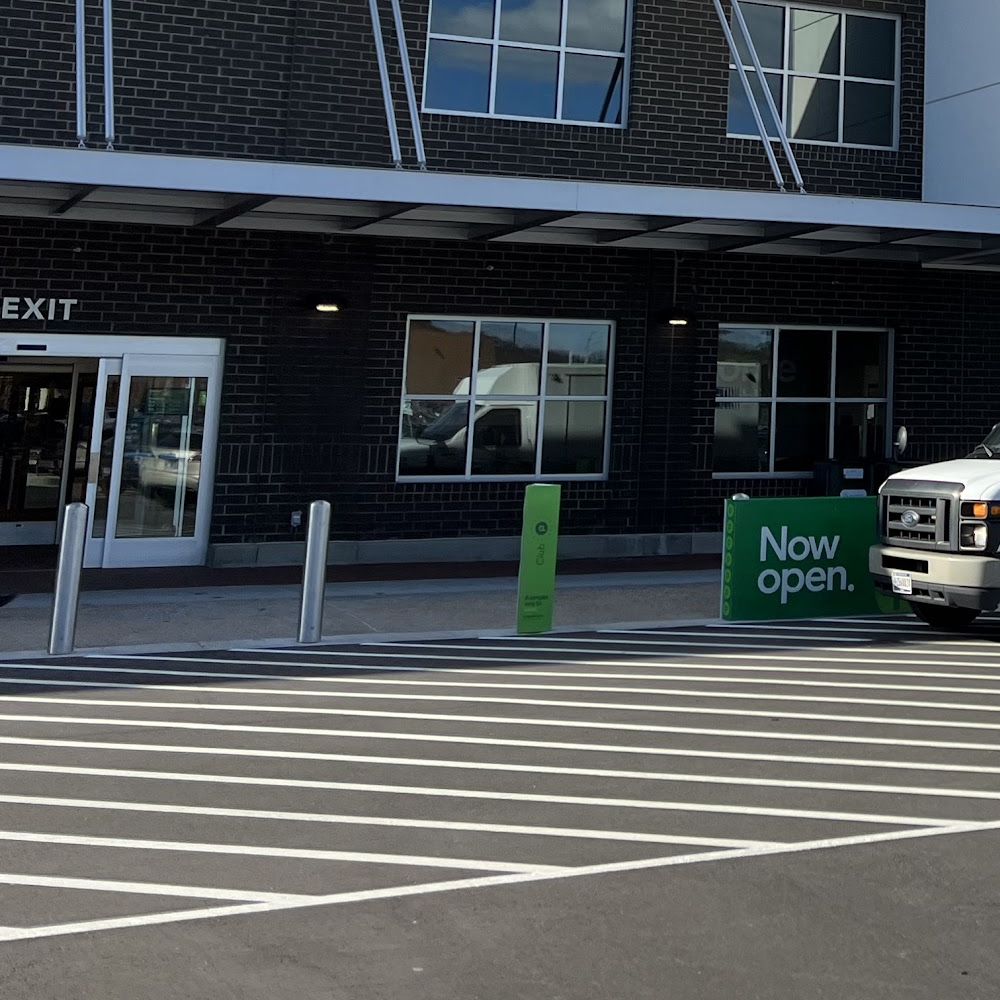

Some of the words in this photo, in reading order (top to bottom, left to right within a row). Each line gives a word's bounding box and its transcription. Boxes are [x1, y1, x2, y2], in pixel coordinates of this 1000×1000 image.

[1, 297, 78, 321] EXIT
[535, 543, 545, 566] Club
[760, 525, 840, 562] Now
[757, 566, 854, 604] open.
